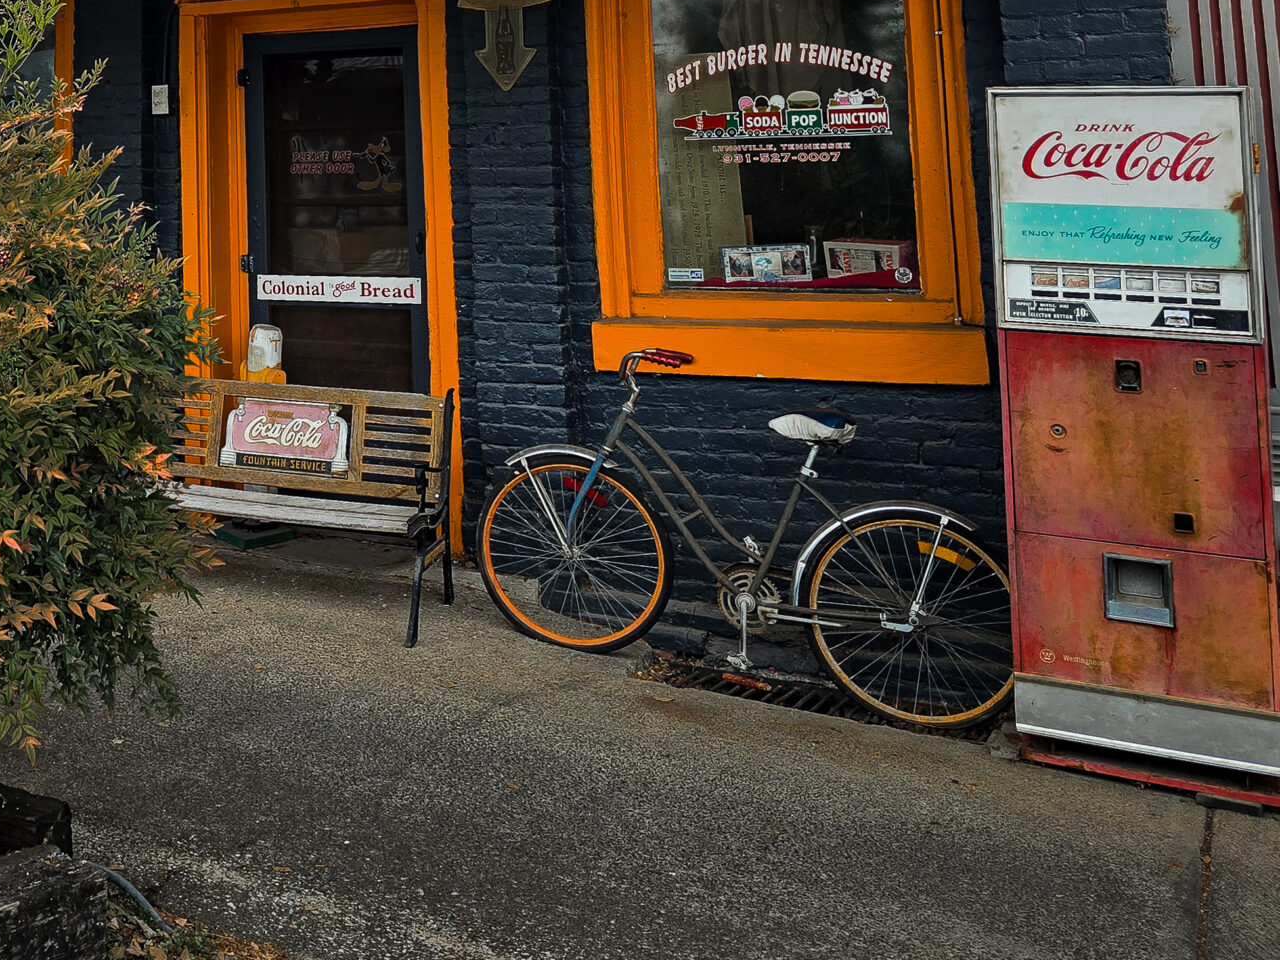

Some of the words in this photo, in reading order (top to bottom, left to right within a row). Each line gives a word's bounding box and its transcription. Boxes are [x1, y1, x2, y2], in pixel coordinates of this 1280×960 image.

[666, 60, 701, 94] BEST
[707, 43, 768, 76] BURGER
[774, 42, 792, 63] IN
[799, 42, 894, 84] TENNESSEE
[745, 116, 780, 128] SODA
[791, 114, 818, 127] POP
[830, 111, 887, 125] JUNCTION
[1074, 123, 1136, 133] DRINK
[780, 142, 851, 150] TENNESSEE
[292, 151, 329, 162] PLEASE
[333, 151, 352, 162] USE
[722, 151, 841, 164] 931-527-0007
[1021, 130, 1223, 183] Coca-Cola
[291, 163, 323, 175] OTHER
[326, 162, 355, 175] DOOR
[1022, 229, 1055, 238] ENJOY
[1059, 230, 1085, 238] THAT
[1086, 226, 1146, 247] Refreshing
[1149, 234, 1174, 242] NEW
[1178, 229, 1222, 250] Feeling
[262, 280, 325, 296] Colonial
[333, 281, 357, 298] good
[359, 282, 415, 298] Bread
[244, 415, 327, 449] Coca-Cola
[243, 455, 286, 467] FOUNTAIN
[290, 460, 326, 471] SERVICE
